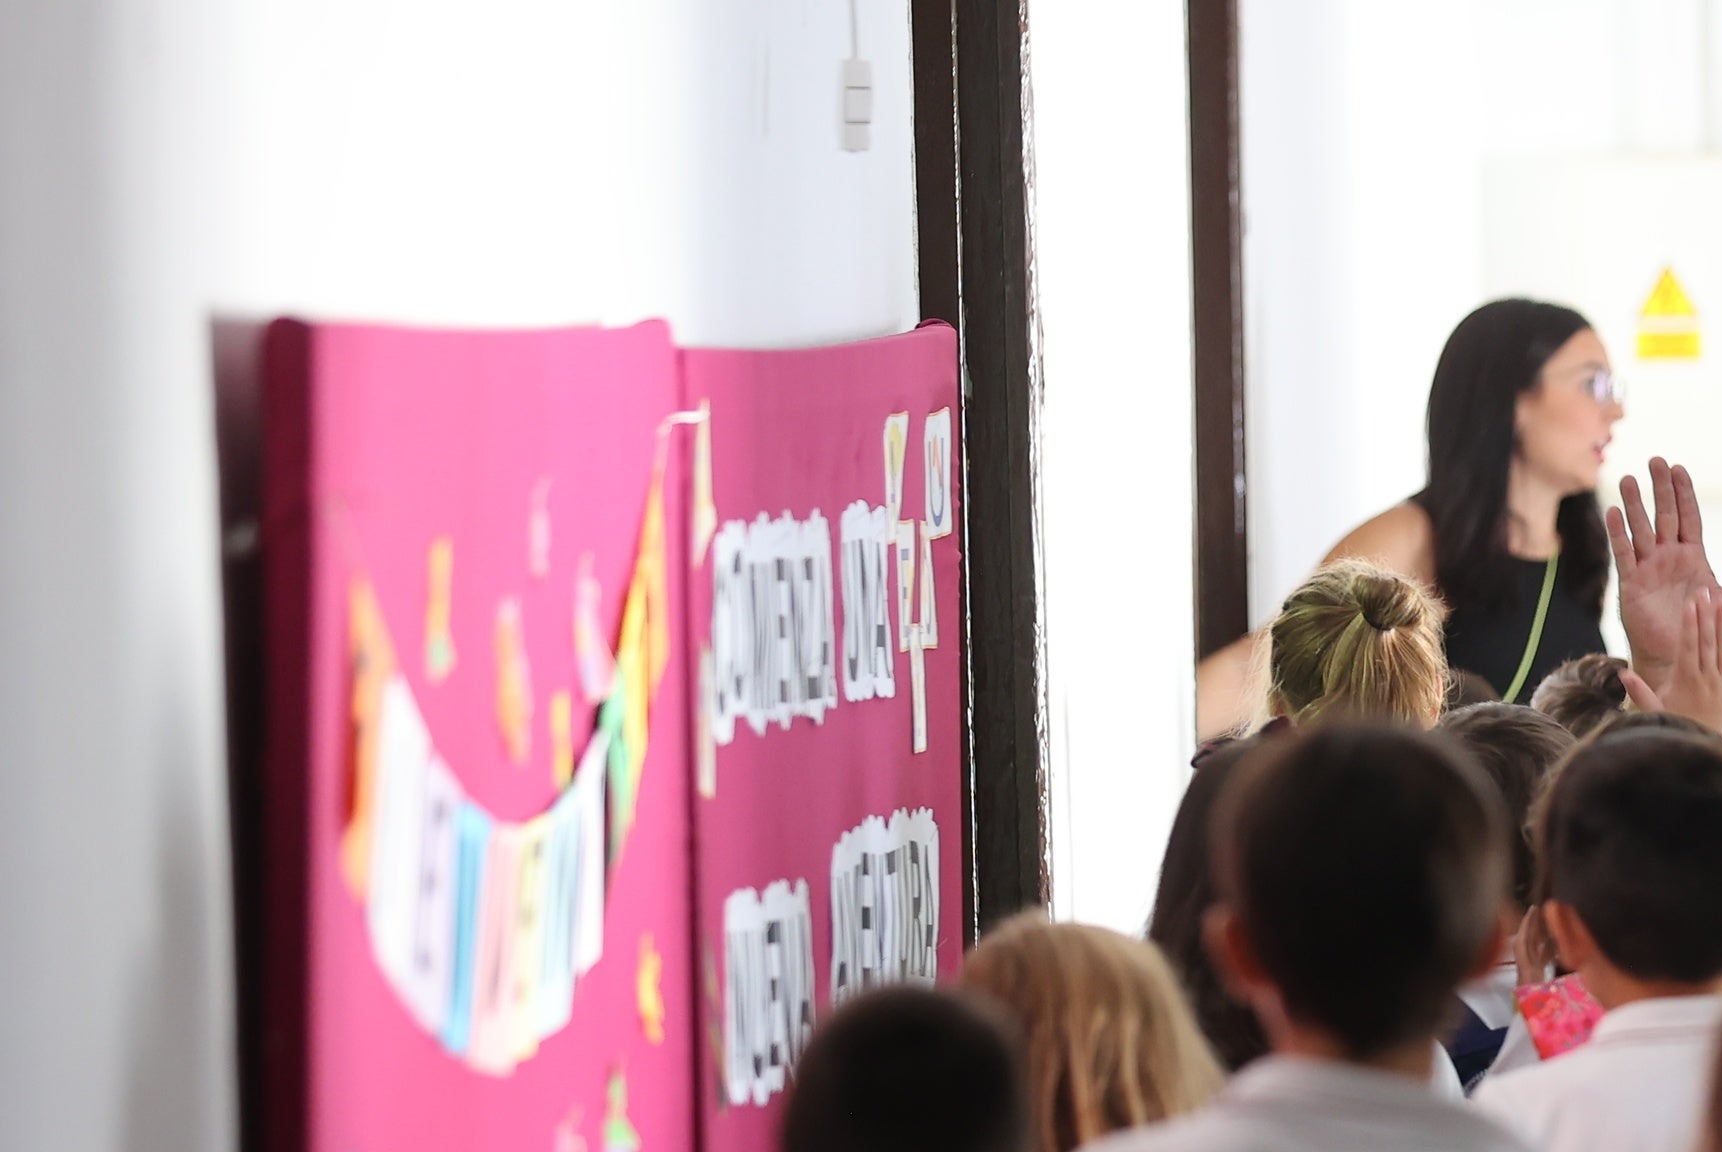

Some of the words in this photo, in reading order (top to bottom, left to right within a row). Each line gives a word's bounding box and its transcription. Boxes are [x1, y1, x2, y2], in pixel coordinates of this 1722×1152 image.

[843, 537, 892, 682] UNA
[726, 917, 814, 1077] NUEVA
[832, 840, 935, 1001] AVENTURA
